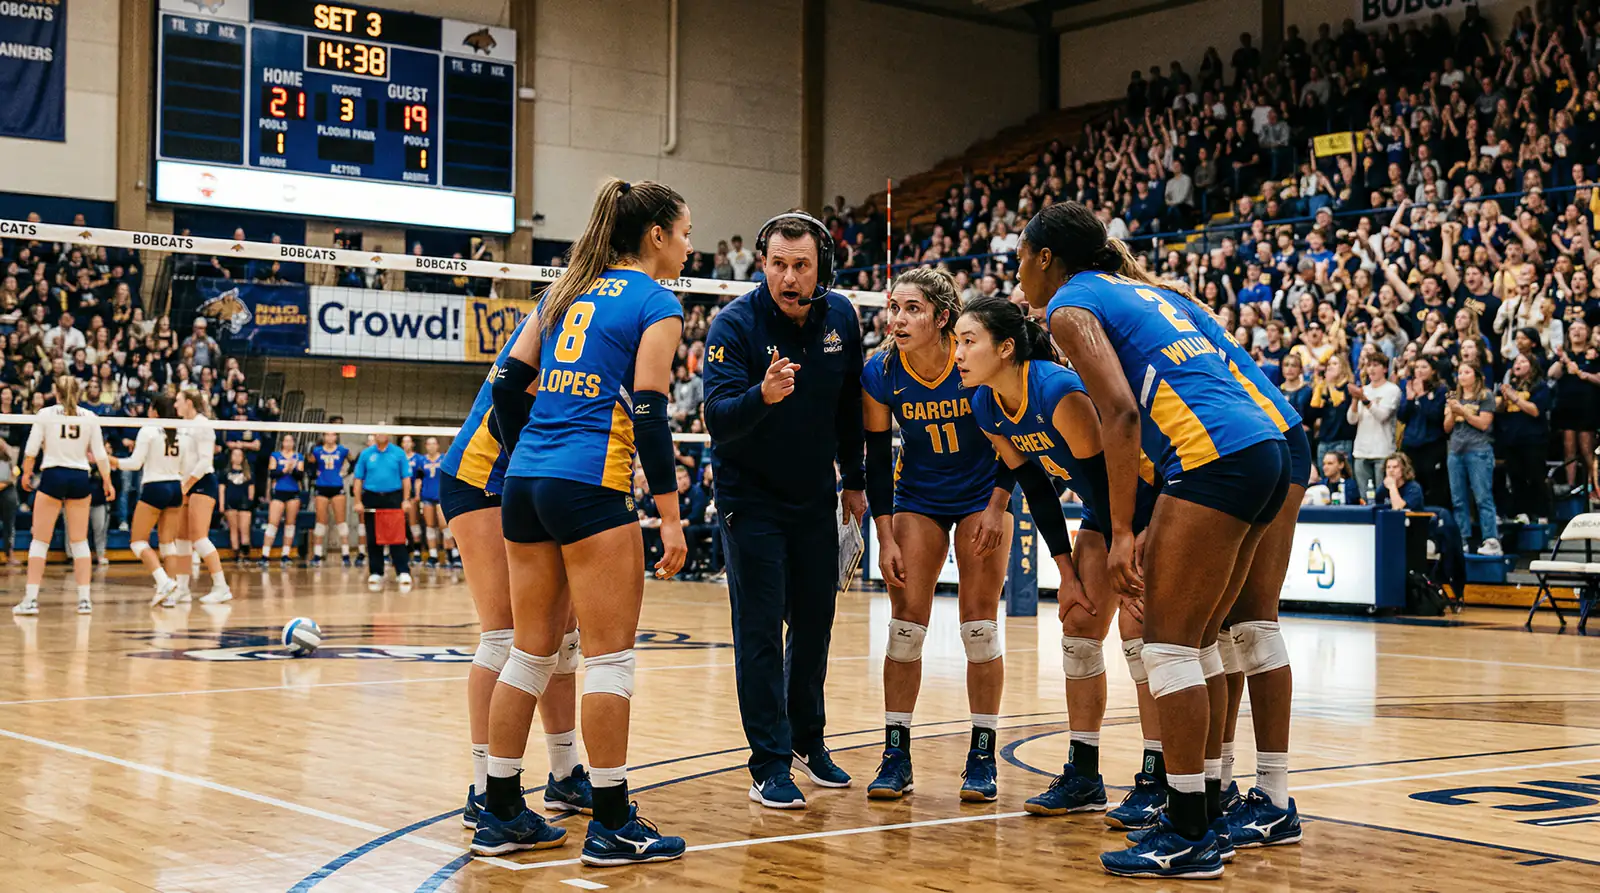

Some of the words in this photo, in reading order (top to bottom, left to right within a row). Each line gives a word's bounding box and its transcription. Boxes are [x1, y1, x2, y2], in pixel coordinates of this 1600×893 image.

[0, 1, 54, 21] OBCATS
[314, 4, 357, 33] SET
[366, 12, 382, 38] 3
[0, 42, 53, 61] ANNERS
[318, 40, 386, 76] 14:38
[263, 67, 303, 87] HOME
[270, 87, 306, 118] 21
[387, 83, 428, 102] GUEST
[340, 98, 354, 121] 3
[404, 105, 427, 132] 19
[277, 133, 284, 153] 1
[421, 149, 427, 168] 1
[0, 222, 37, 236] CATS
[133, 233, 194, 249] BOBCATS
[280, 246, 337, 261] BOBCATS
[416, 258, 467, 271] BOBCATS
[581, 277, 629, 297] PES
[1134, 288, 1199, 332] 2
[317, 301, 461, 341] Crowd!
[553, 301, 596, 363] 8
[707, 345, 725, 363] 54
[538, 368, 601, 398] LOPES
[902, 398, 973, 420] GARCIA
[925, 422, 960, 454] 11
[1011, 431, 1055, 452] CHEN
[1038, 455, 1073, 481] 4
